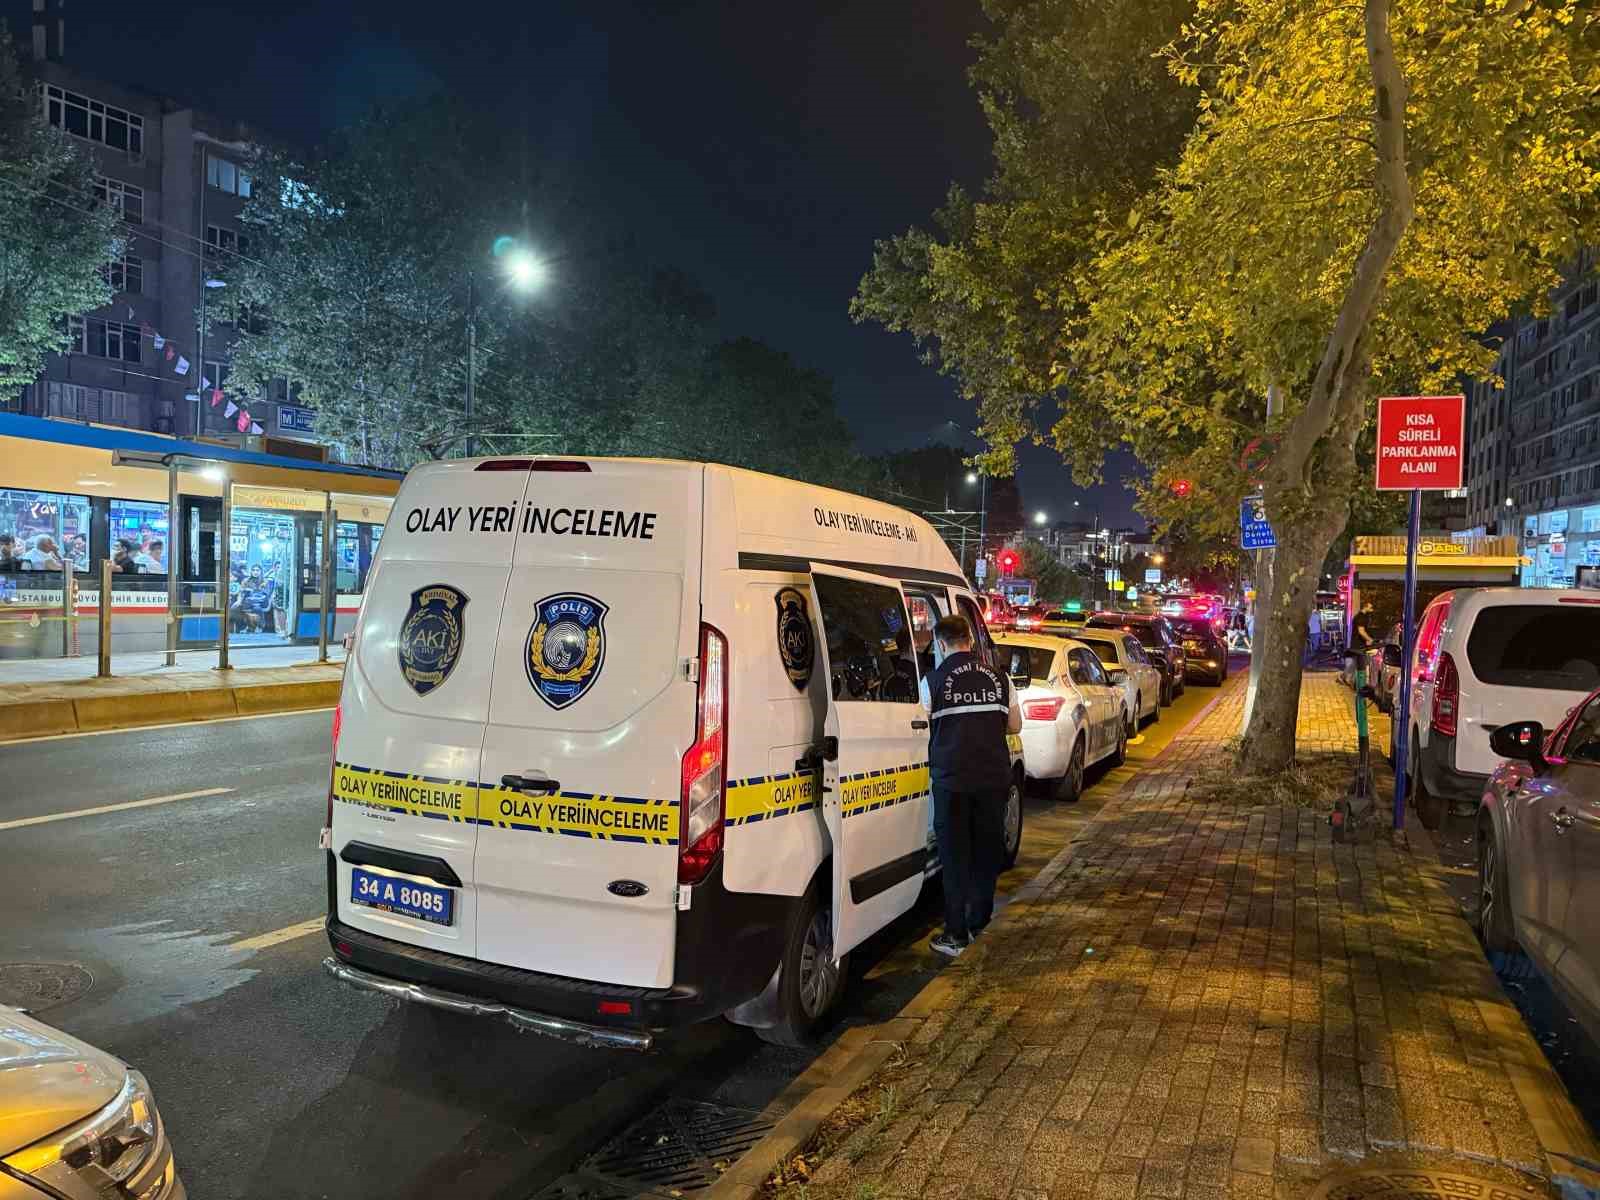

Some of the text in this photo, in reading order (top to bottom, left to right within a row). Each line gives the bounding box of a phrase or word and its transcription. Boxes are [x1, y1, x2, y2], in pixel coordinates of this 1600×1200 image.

[1406, 413, 1435, 426] KISA
[1398, 427, 1441, 442] SÜRELİ
[1382, 446, 1457, 458] PARKLANMA
[1400, 461, 1437, 473] ALANI
[406, 500, 657, 540] OLAY YERİ İNCELEME
[814, 507, 840, 529] OLAY
[953, 688, 997, 704] POLİS
[339, 774, 368, 796] OLAY
[774, 780, 813, 804] OLAY YER
[842, 789, 860, 805] OLAY
[499, 799, 544, 820] OLAY
[359, 876, 444, 912] 34 A 8085
